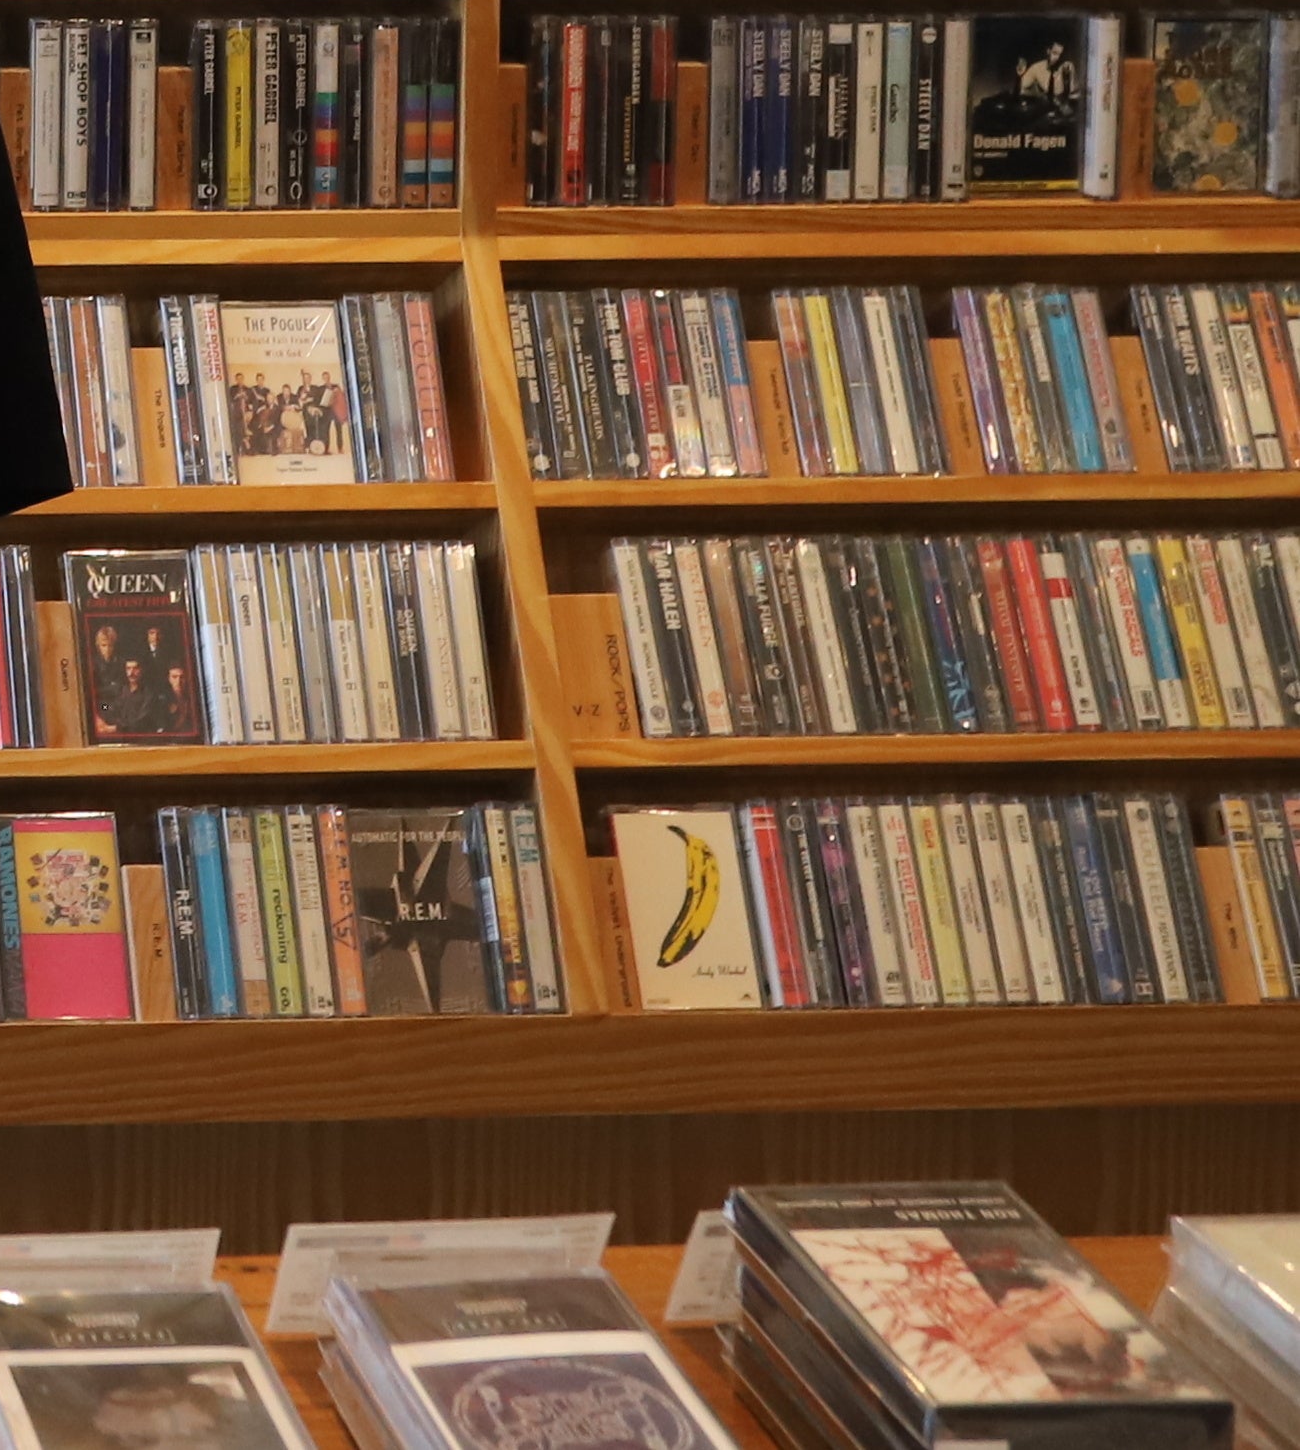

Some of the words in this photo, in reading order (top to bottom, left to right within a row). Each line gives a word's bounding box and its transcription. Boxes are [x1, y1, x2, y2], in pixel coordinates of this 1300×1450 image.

[76, 34, 88, 58] PET
[264, 32, 278, 71] PETER
[809, 30, 822, 66] STEELY
[76, 63, 88, 103] SHOP
[264, 75, 278, 125] GABRIEL
[809, 70, 822, 96] DAN
[76, 108, 88, 147] BOYS
[974, 134, 1020, 150] Donald
[1025, 134, 1066, 150] Fagen
[244, 316, 266, 333] THE
[270, 316, 316, 333] POGUES
[154, 390, 165, 407] The
[155, 412, 167, 448] Pogues
[86, 566, 166, 597] QUEEN
[240, 594, 253, 626] Queen
[60, 658, 71, 692] Queen
[605, 634, 631, 732] ROCK/POPS
[606, 867, 619, 887] The
[176, 889, 192, 940] R.E.M.
[272, 889, 289, 963] reckoning
[399, 902, 447, 921] R.E.M.
[608, 891, 624, 929] Velvet
[611, 935, 633, 1007] Underground
